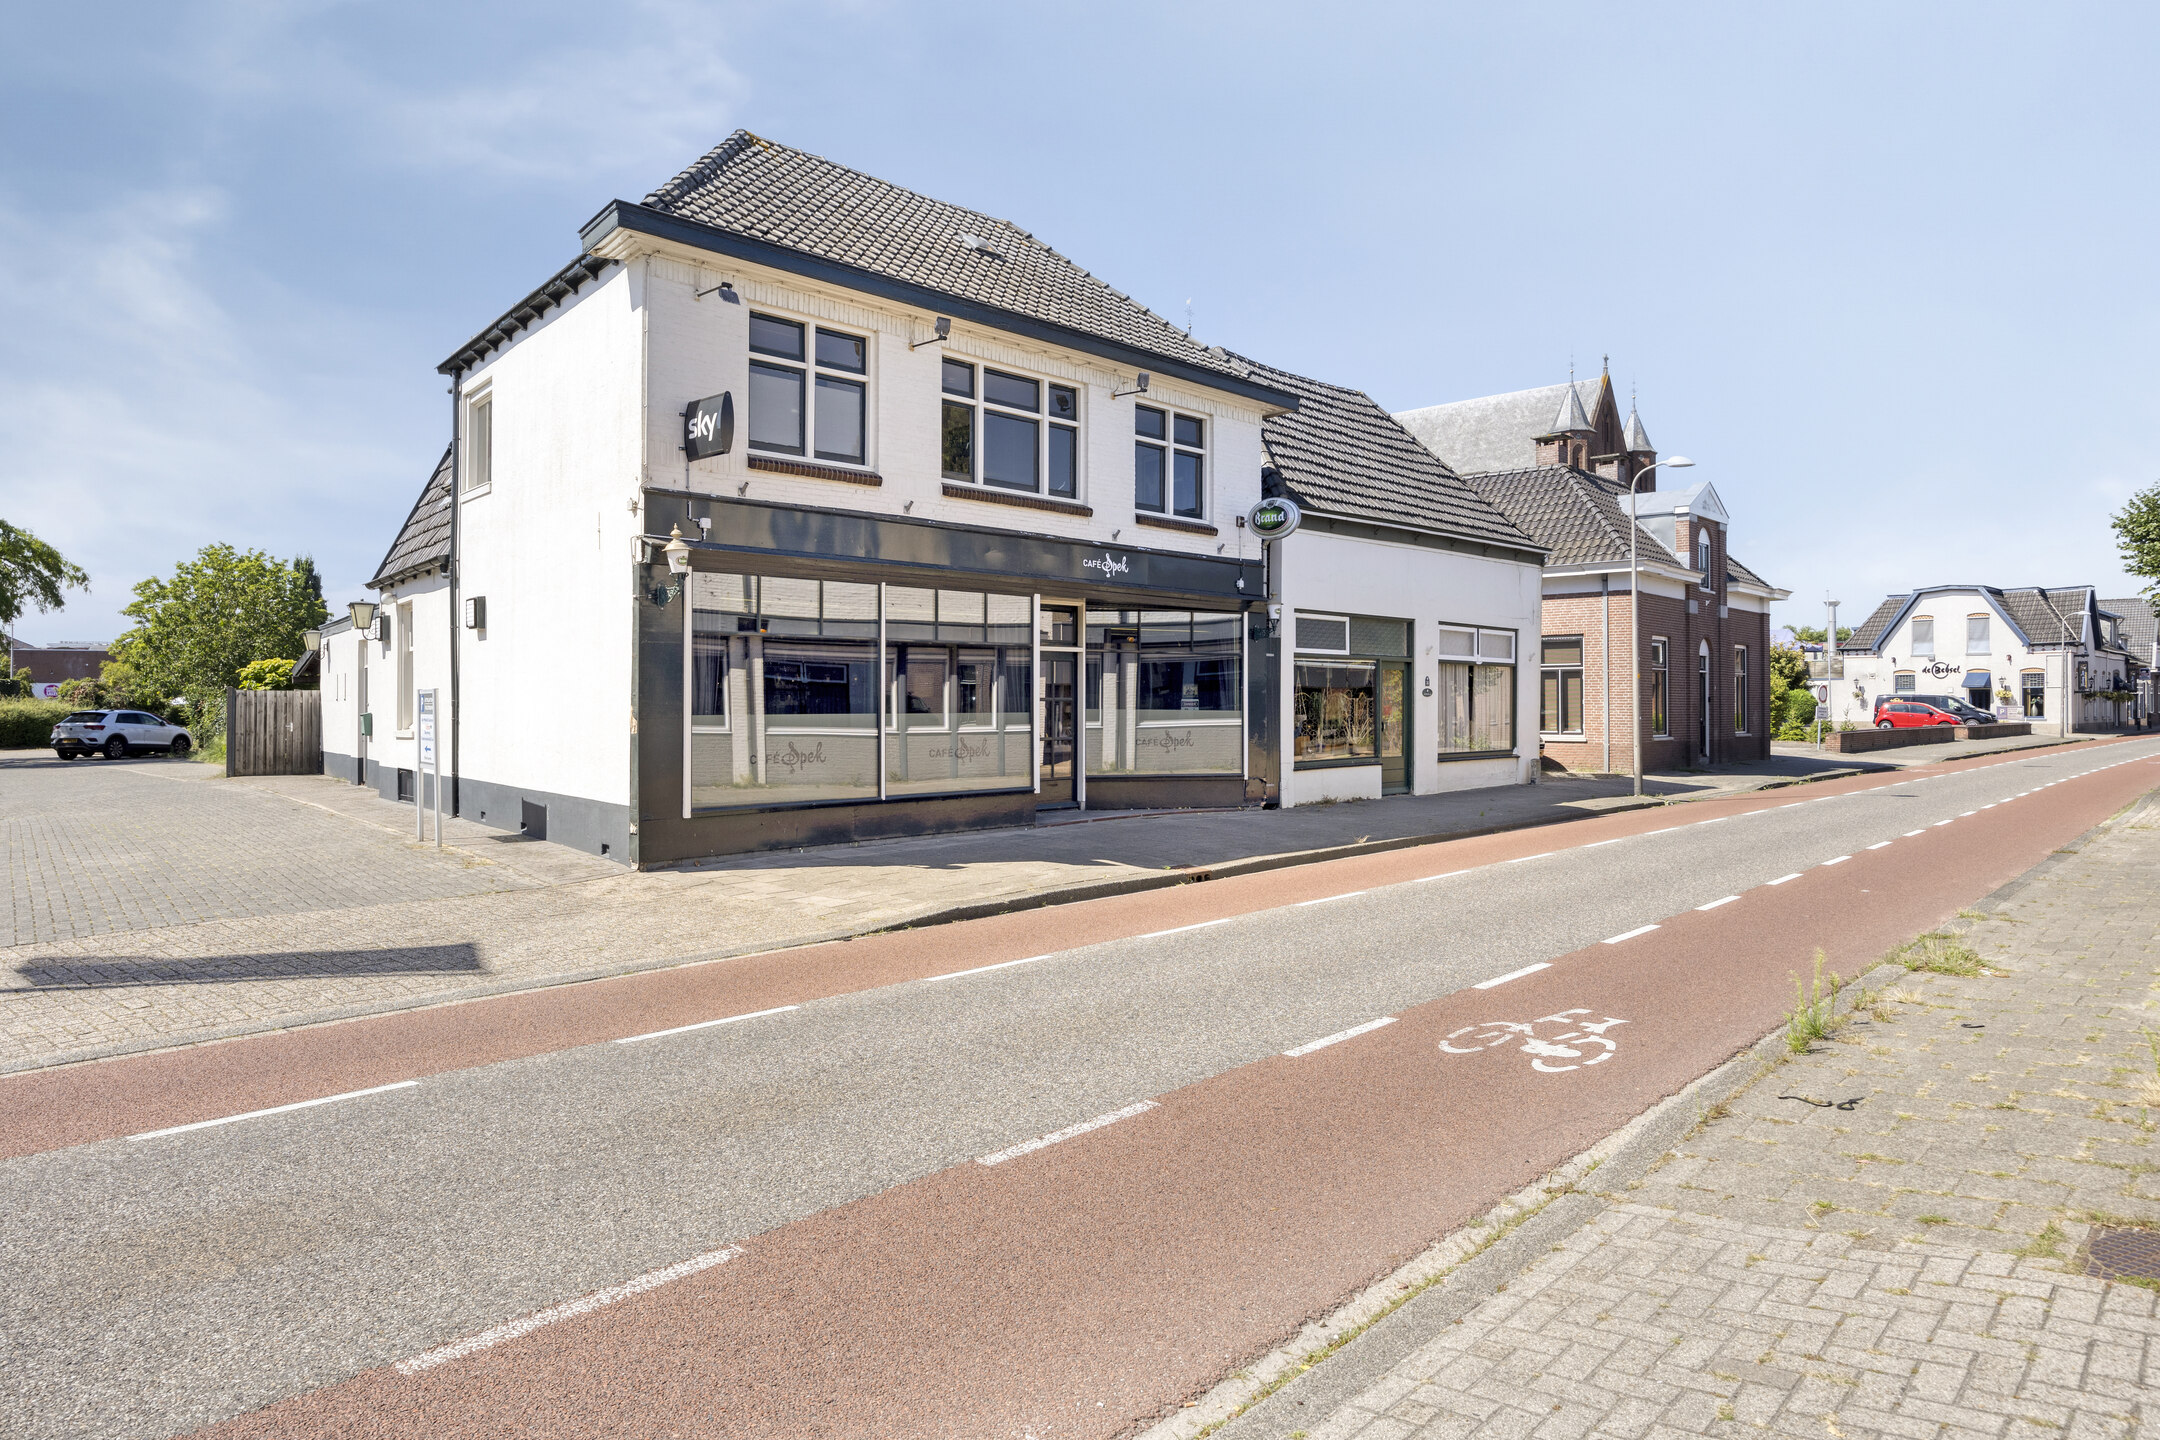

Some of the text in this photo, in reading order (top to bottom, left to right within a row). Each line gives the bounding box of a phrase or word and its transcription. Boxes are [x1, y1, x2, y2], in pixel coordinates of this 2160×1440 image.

[688, 410, 717, 441] sky
[1255, 511, 1285, 525] Brand
[1083, 553, 1129, 577] CAFÉ Spek
[1931, 662, 1961, 679] Bebsel
[929, 737, 990, 763] CAFÉ Spek
[1136, 730, 1194, 753] CAFÉ Spek
[750, 741, 827, 774] CFÉ Spek
